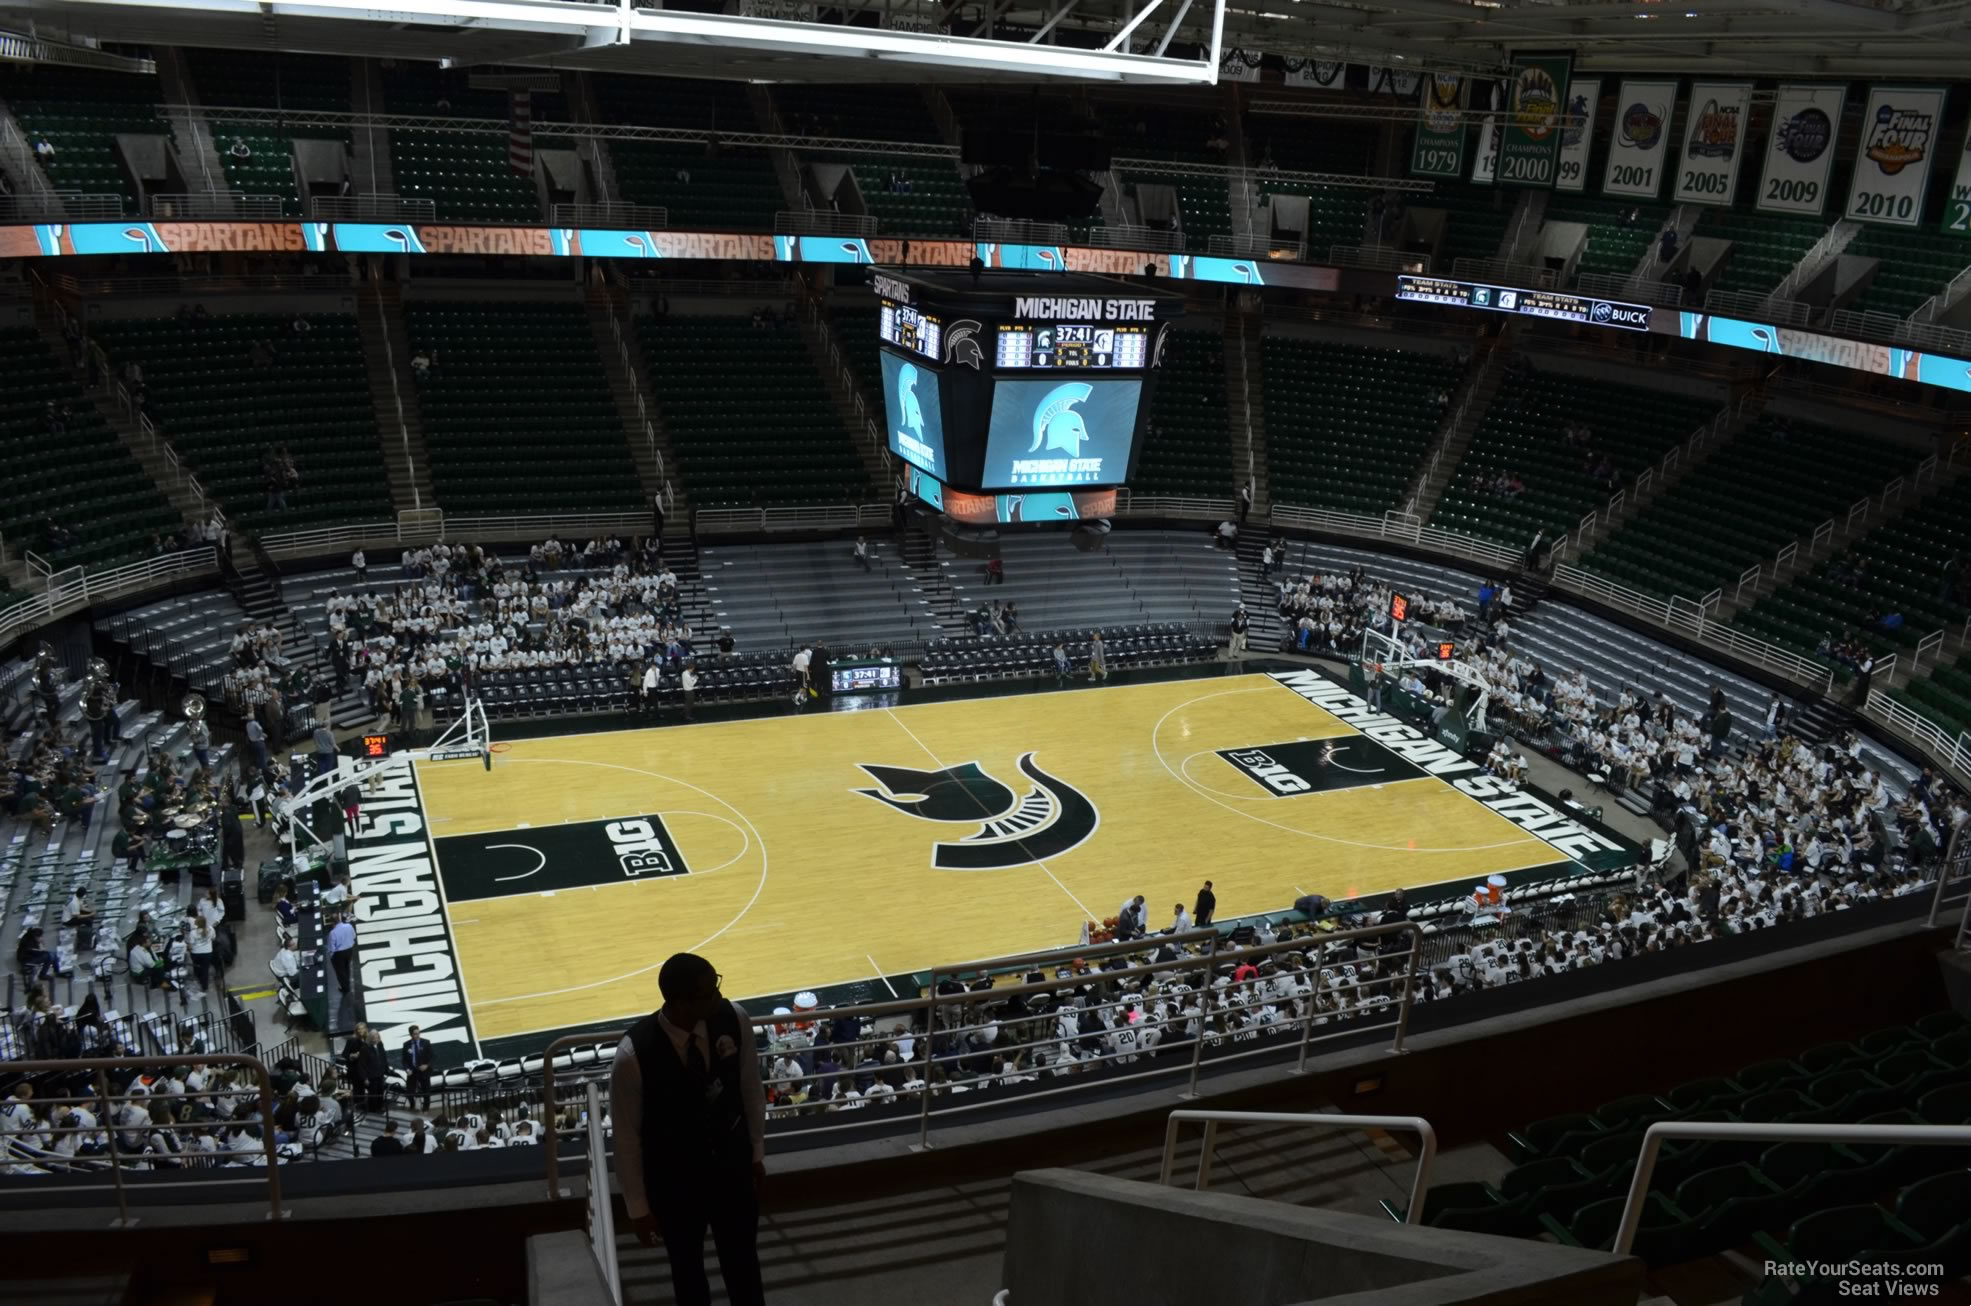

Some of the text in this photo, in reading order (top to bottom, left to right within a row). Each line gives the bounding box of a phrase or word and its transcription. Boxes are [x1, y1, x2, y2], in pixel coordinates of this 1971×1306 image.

[1418, 150, 1457, 171] 1979
[1503, 155, 1549, 180] 2000
[1612, 165, 1653, 187] 2001
[1682, 171, 1728, 194] 2005
[1766, 178, 1818, 203] 2009
[1854, 192, 1913, 218] 2010
[160, 222, 302, 253] SPARTANS
[418, 226, 552, 256] SPARTANS
[655, 234, 776, 261] SPARTANS
[1065, 248, 1170, 276] SPARTANS
[874, 274, 910, 304] SPARTANS
[1412, 279, 1433, 287] TEAM
[1532, 293, 1554, 301] TEAM
[1014, 297, 1156, 321] MICHIGAN STATE
[1612, 309, 1648, 324] BUICK
[1056, 328, 1091, 341] 37:41
[1038, 354, 1046, 366] 0
[1098, 354, 1106, 366] 0
[1779, 328, 1890, 375] SPARTANS
[1012, 458, 1103, 474] MICHIGAN STATE
[1010, 473, 1099, 483] BASKETBALL
[854, 670, 876, 679] 37:41
[1442, 728, 1460, 744] xfinity
[369, 744, 383, 756] 35
[1271, 668, 1626, 861] MICHIGAN STATE
[347, 841, 469, 1051] MICHIGAN
[1118, 1031, 1134, 1044] 20
[300, 1117, 316, 1129] 20
